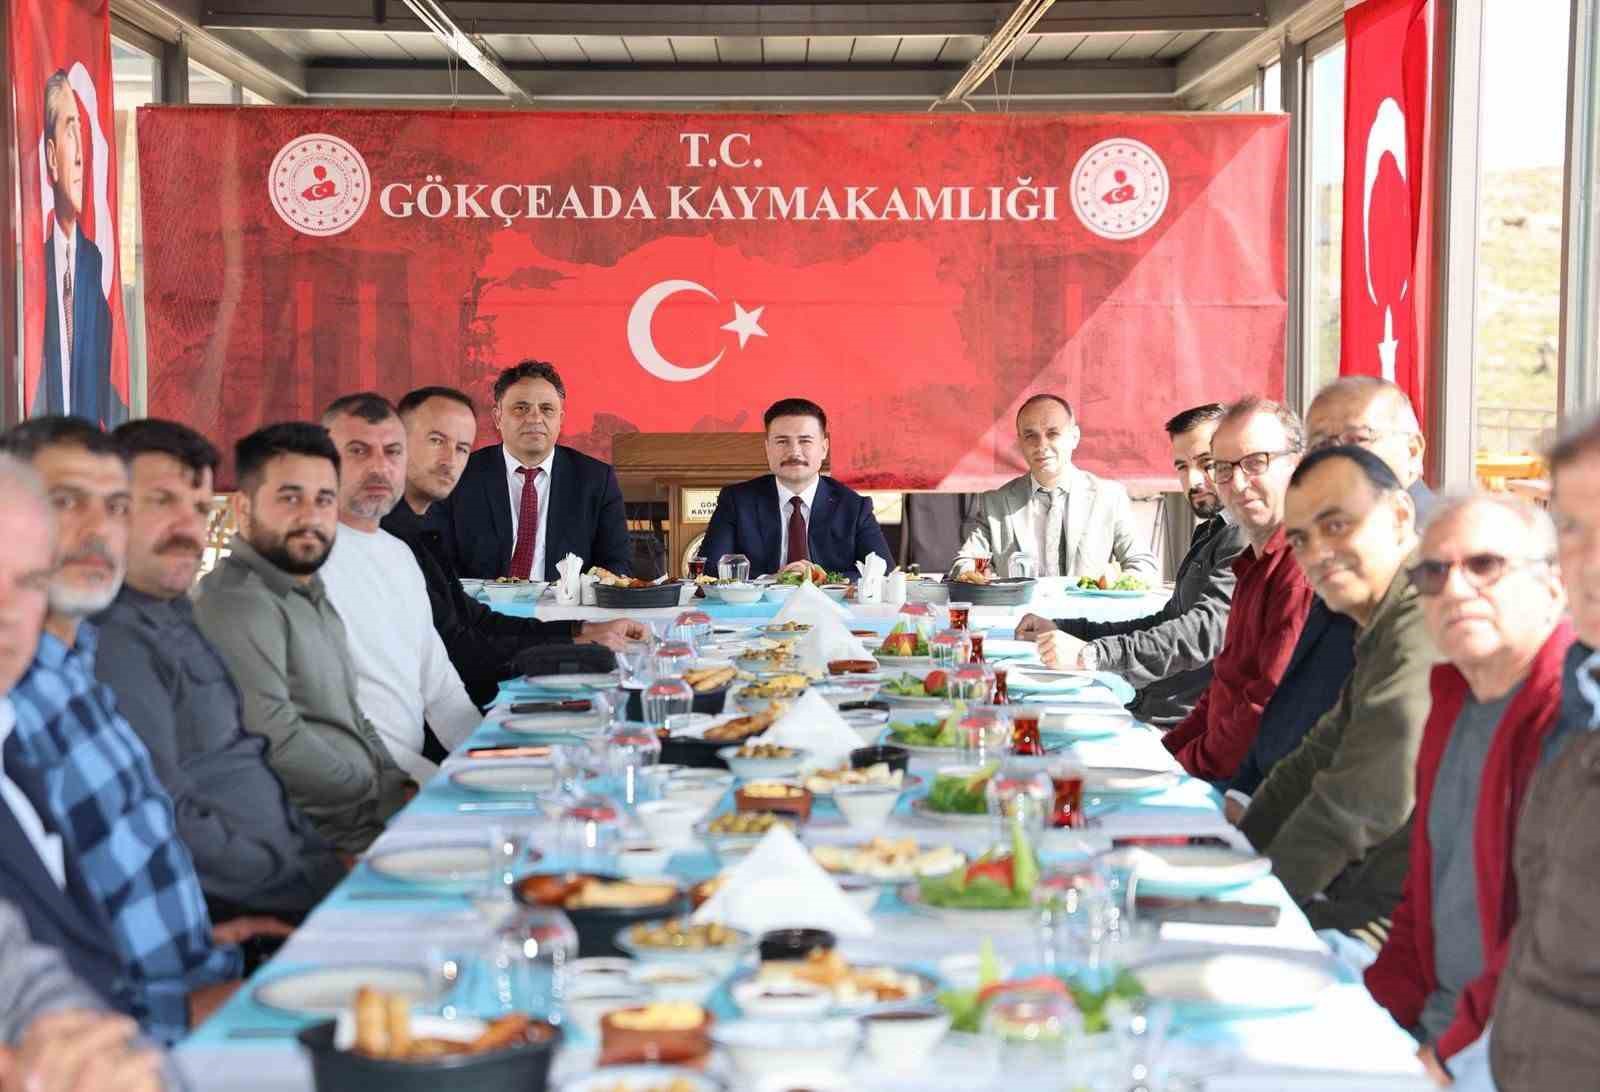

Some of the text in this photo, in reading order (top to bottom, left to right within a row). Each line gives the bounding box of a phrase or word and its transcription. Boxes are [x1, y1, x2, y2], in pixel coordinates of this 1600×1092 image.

[680, 132, 763, 168] T.C.
[379, 175, 655, 226] GÖKÇEADA
[667, 175, 1056, 221] KAYMAKAMLIĞI
